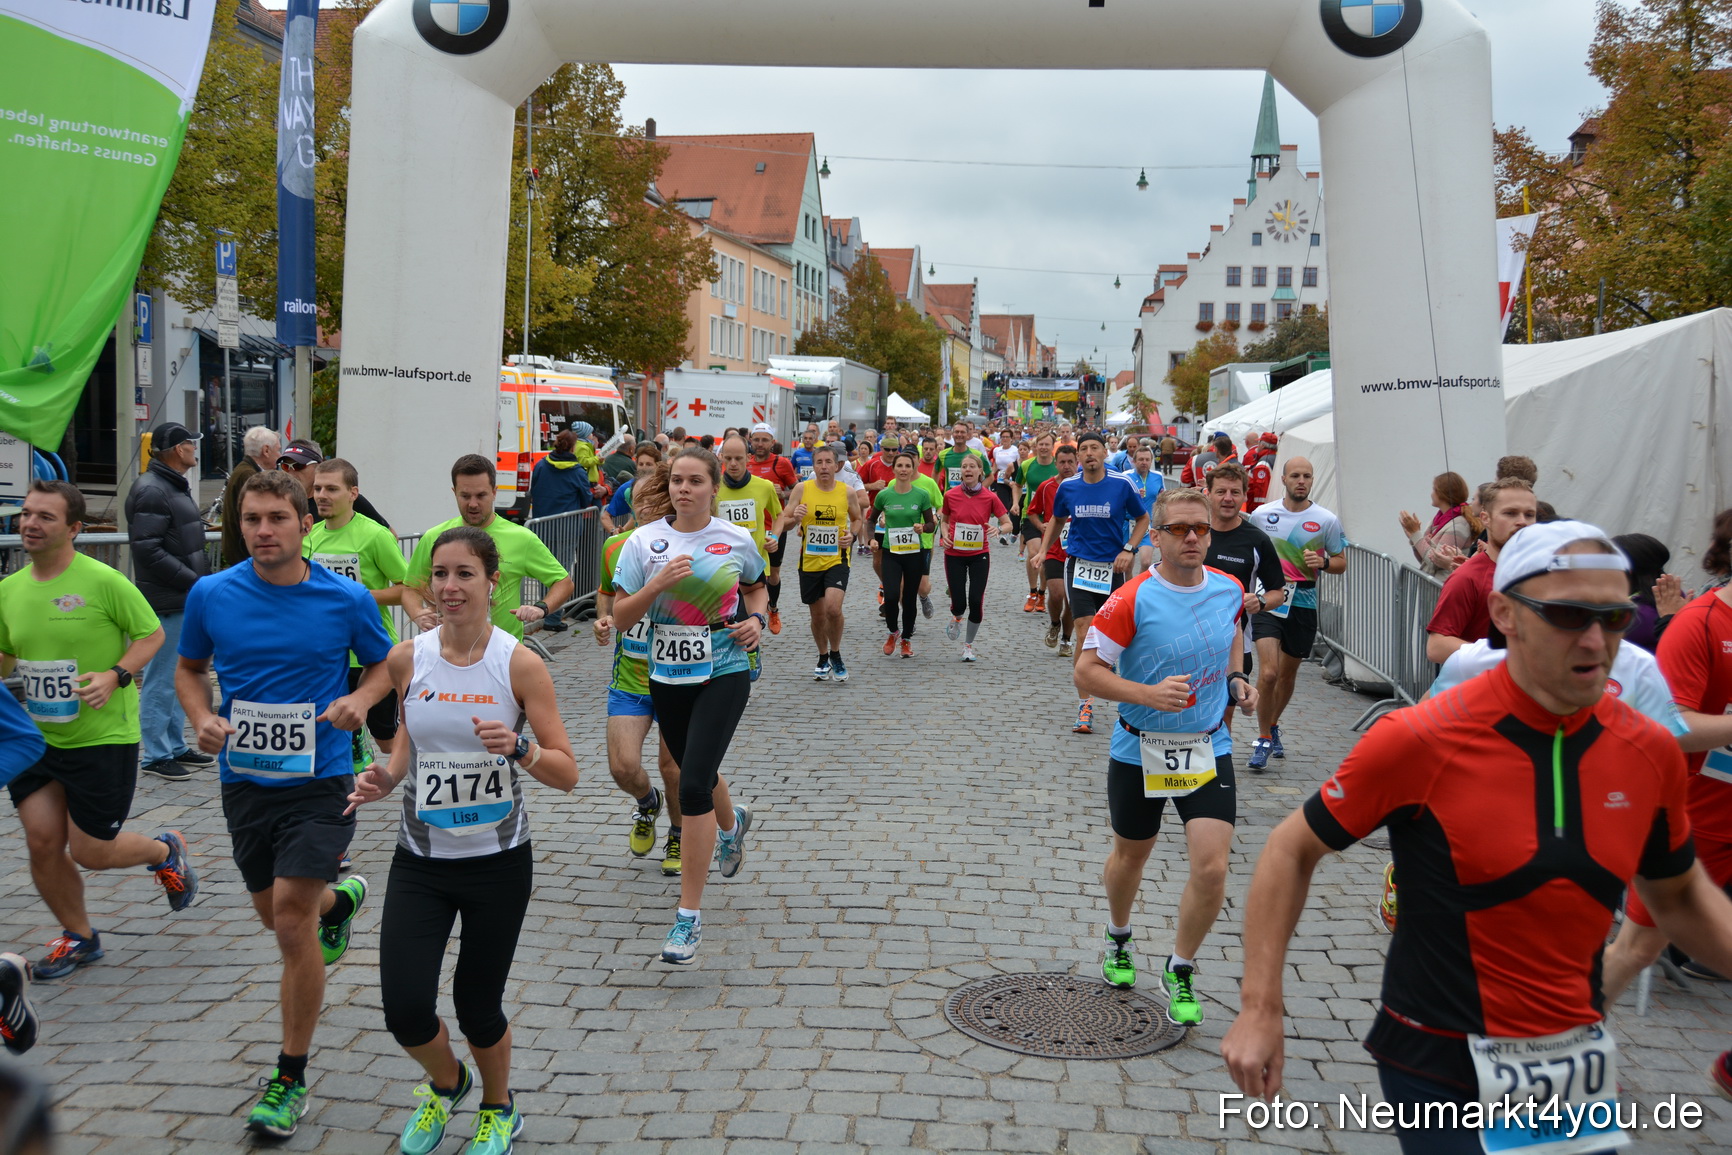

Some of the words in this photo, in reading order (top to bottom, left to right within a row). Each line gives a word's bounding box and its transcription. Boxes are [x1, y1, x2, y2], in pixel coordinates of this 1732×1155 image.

[170, 361, 178, 376] 3
[342, 364, 472, 383] www.bmw-laufsport.de
[726, 507, 749, 521] 168
[1074, 504, 1111, 514] HUBER
[809, 532, 836, 545] 2403
[895, 533, 913, 544] 187
[961, 530, 979, 541] 167
[1078, 566, 1109, 582] 2192
[656, 639, 706, 662] 2463
[666, 667, 692, 676] Laura
[23, 675, 73, 699] 2765
[437, 692, 499, 705] KLEBL
[32, 703, 59, 713] Tobias
[232, 707, 256, 717] PARTL
[257, 710, 299, 719] Neumarkt
[236, 720, 306, 751] 2585
[1141, 737, 1166, 746] PARTL
[1168, 737, 1200, 746] Neumarkt
[253, 757, 284, 770] Franz
[419, 761, 447, 770] PARTL
[448, 760, 493, 770] Neumarkt
[1164, 748, 1193, 771] 57
[425, 770, 504, 806] 2174
[1164, 776, 1199, 788] Markus
[452, 811, 479, 824] Lisa
[1525, 1033, 1585, 1053] Neumarkt
[1493, 1049, 1606, 1111] 2570
